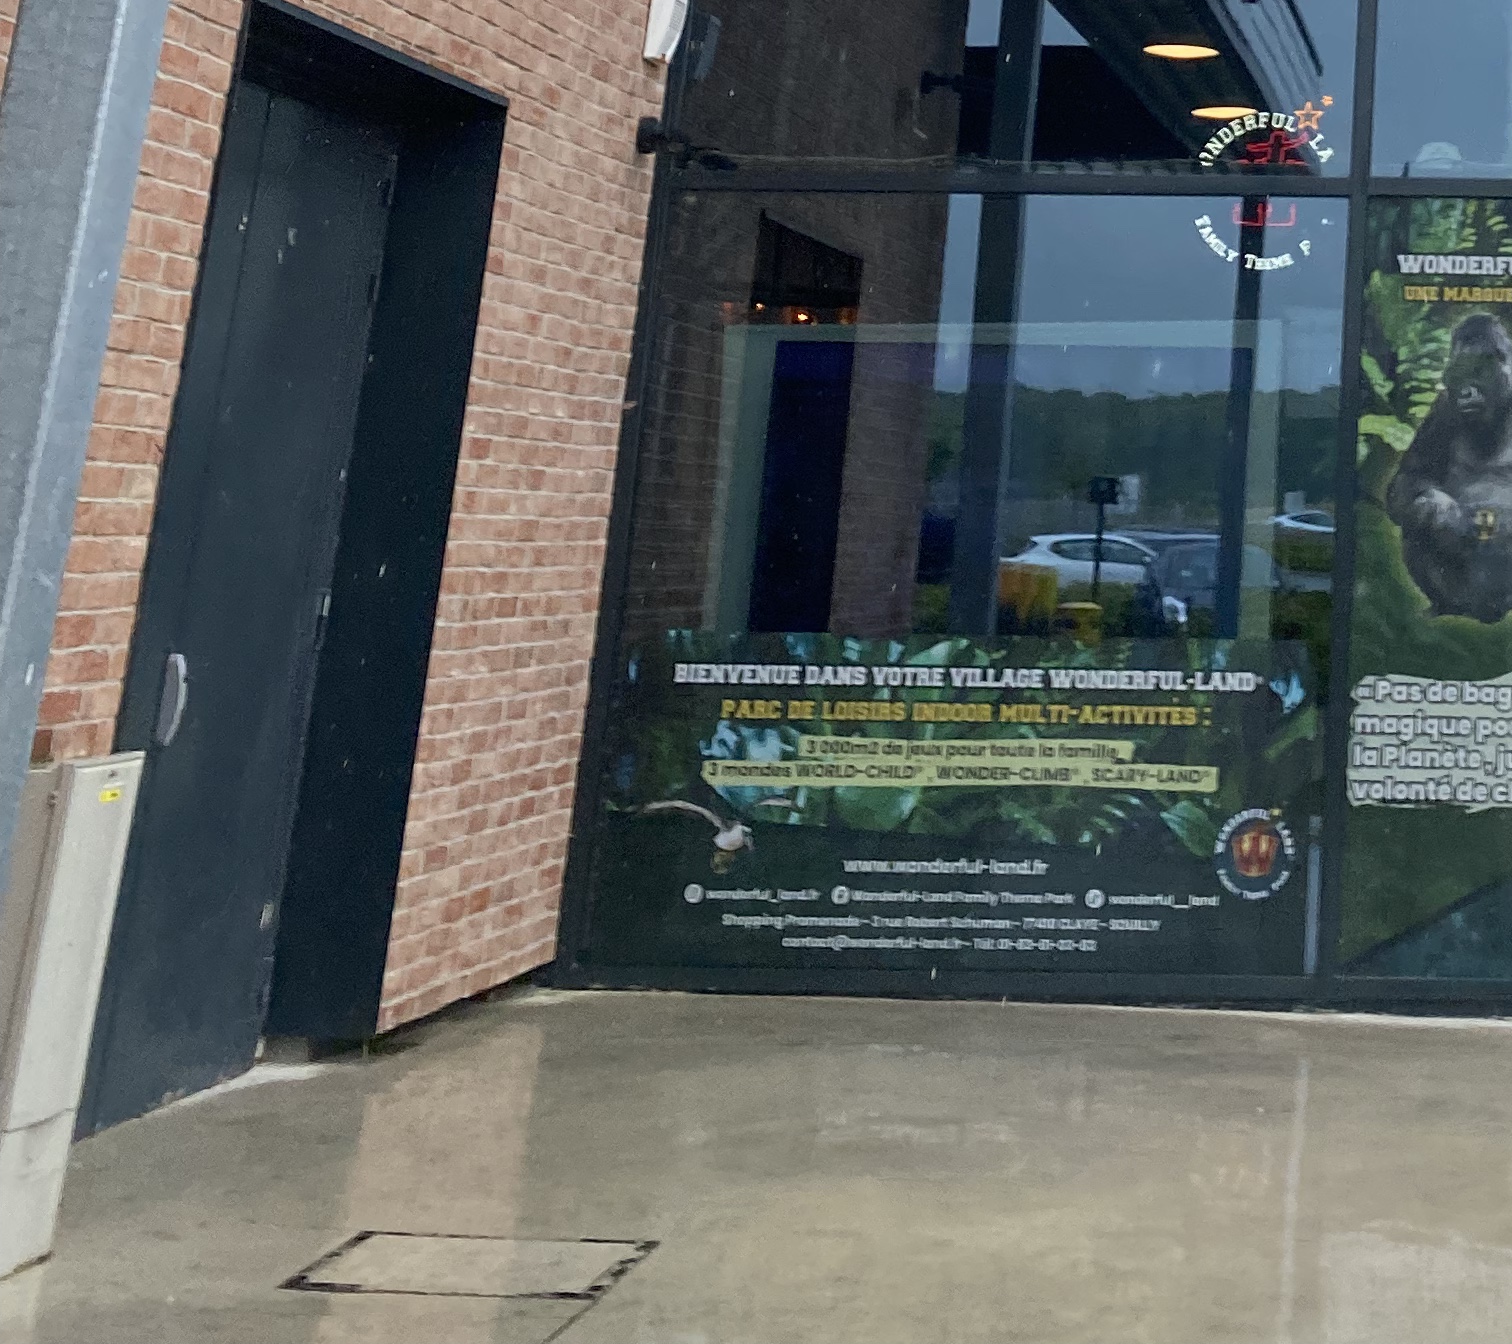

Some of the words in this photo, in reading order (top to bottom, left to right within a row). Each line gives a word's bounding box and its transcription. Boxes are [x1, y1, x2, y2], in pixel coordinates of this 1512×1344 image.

[1198, 112, 1297, 167] ONDERFUL
[673, 663, 800, 685] BIENVENUE
[804, 665, 868, 686] DANS
[872, 666, 945, 687] VOTRE
[951, 667, 1045, 688] VILLAGE
[1375, 680, 1422, 703] Pas
[1426, 681, 1459, 703] de
[721, 699, 782, 720] PARC
[787, 700, 816, 720] DE
[821, 700, 906, 721] LOISIRS
[911, 701, 992, 723] INDOOR
[1354, 710, 1473, 743] magique
[882, 740, 903, 756] de
[1352, 743, 1377, 767] la
[720, 763, 792, 779] mondes
[1350, 775, 1453, 802] volonté
[1455, 777, 1489, 802] de
